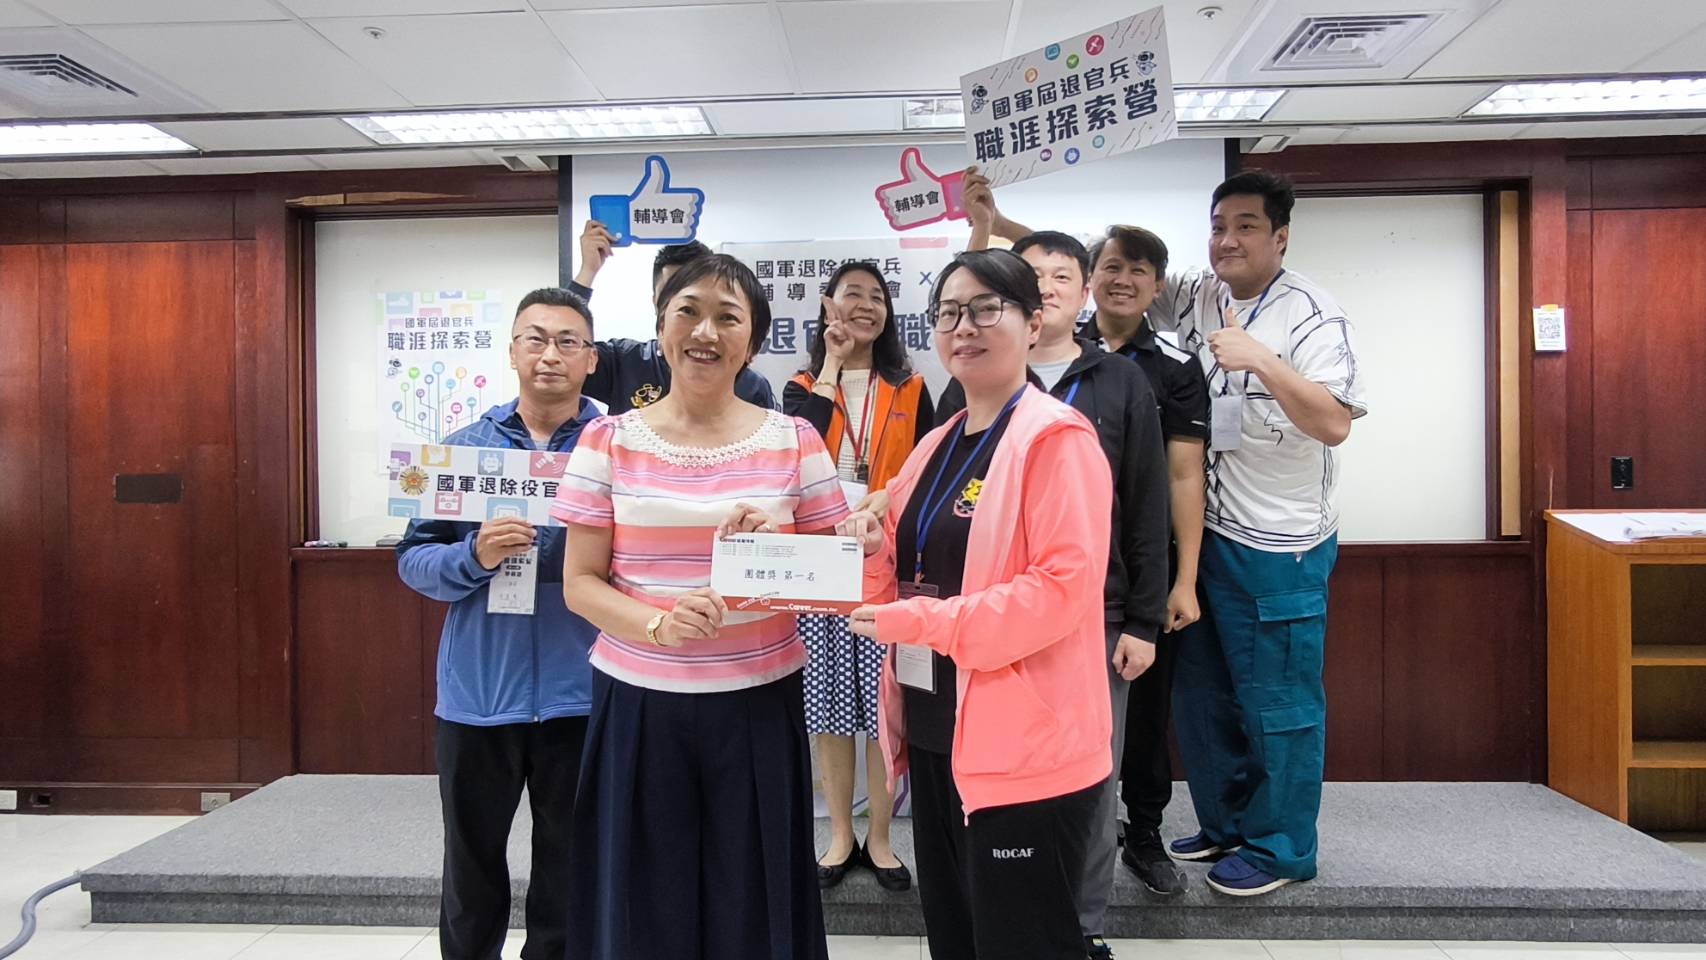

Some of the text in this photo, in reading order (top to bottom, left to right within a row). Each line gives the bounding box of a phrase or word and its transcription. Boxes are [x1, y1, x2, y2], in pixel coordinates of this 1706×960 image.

[991, 57, 1131, 121] 國軍屆退官兵
[974, 78, 1158, 163] 職涯探索營
[894, 190, 940, 213] 輔導會
[633, 208, 685, 224] 輔導會
[405, 316, 474, 329] 國軍屆退官兵
[387, 330, 492, 351] 職涯探索營
[437, 474, 560, 498] 國軍退除役官
[992, 848, 1035, 859] ROCAF
